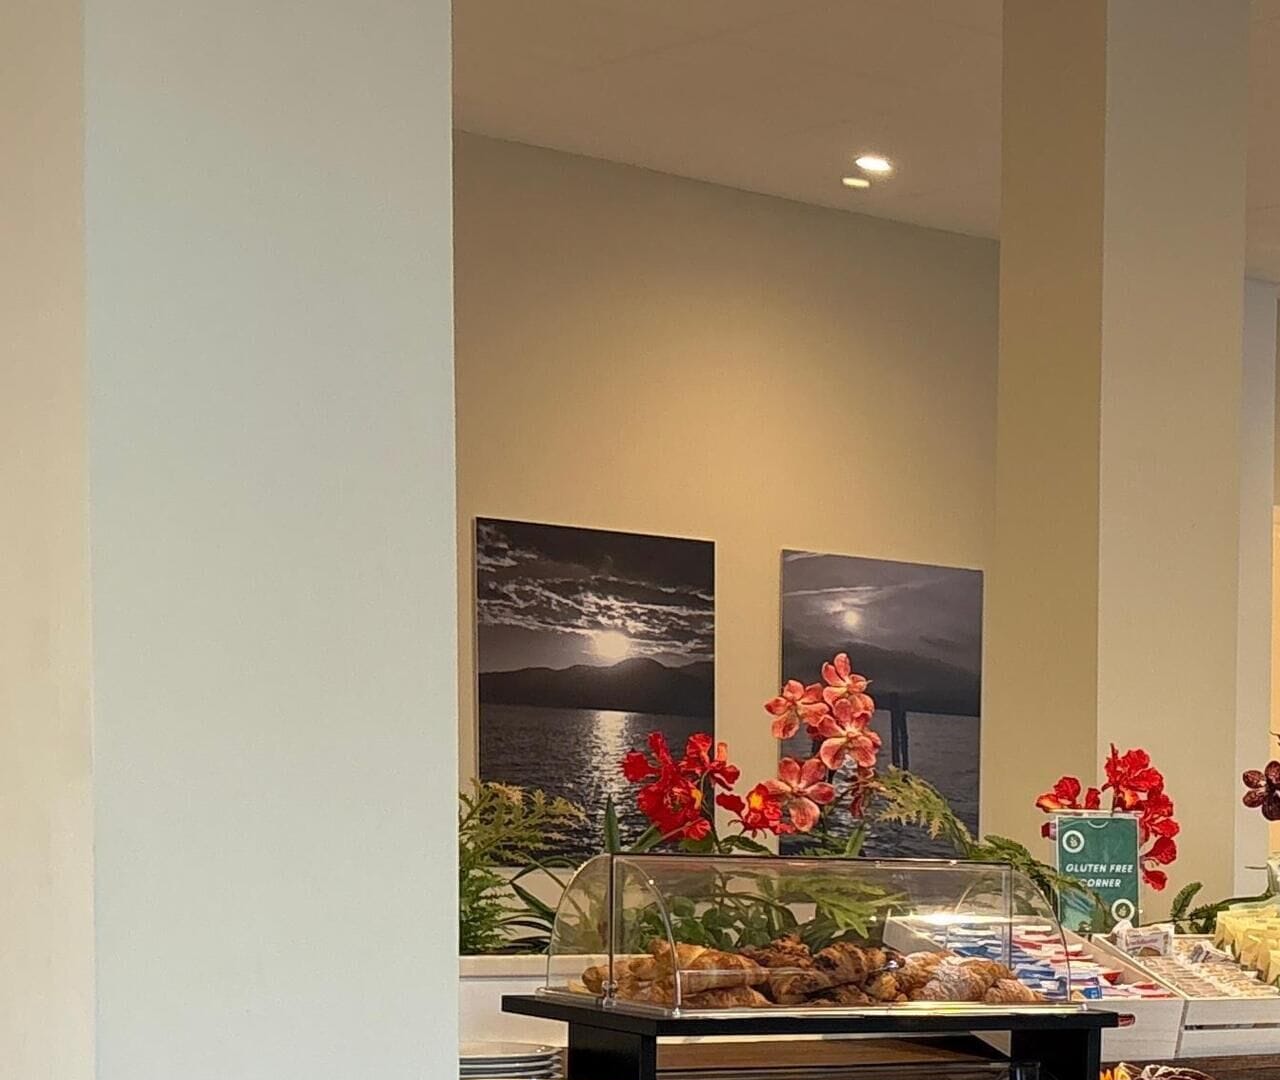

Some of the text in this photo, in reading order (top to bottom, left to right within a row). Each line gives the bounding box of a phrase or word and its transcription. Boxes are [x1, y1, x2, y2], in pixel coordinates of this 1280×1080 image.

[1065, 863, 1134, 873] GLUTEN FREE
[1078, 878, 1122, 888] CORNER
